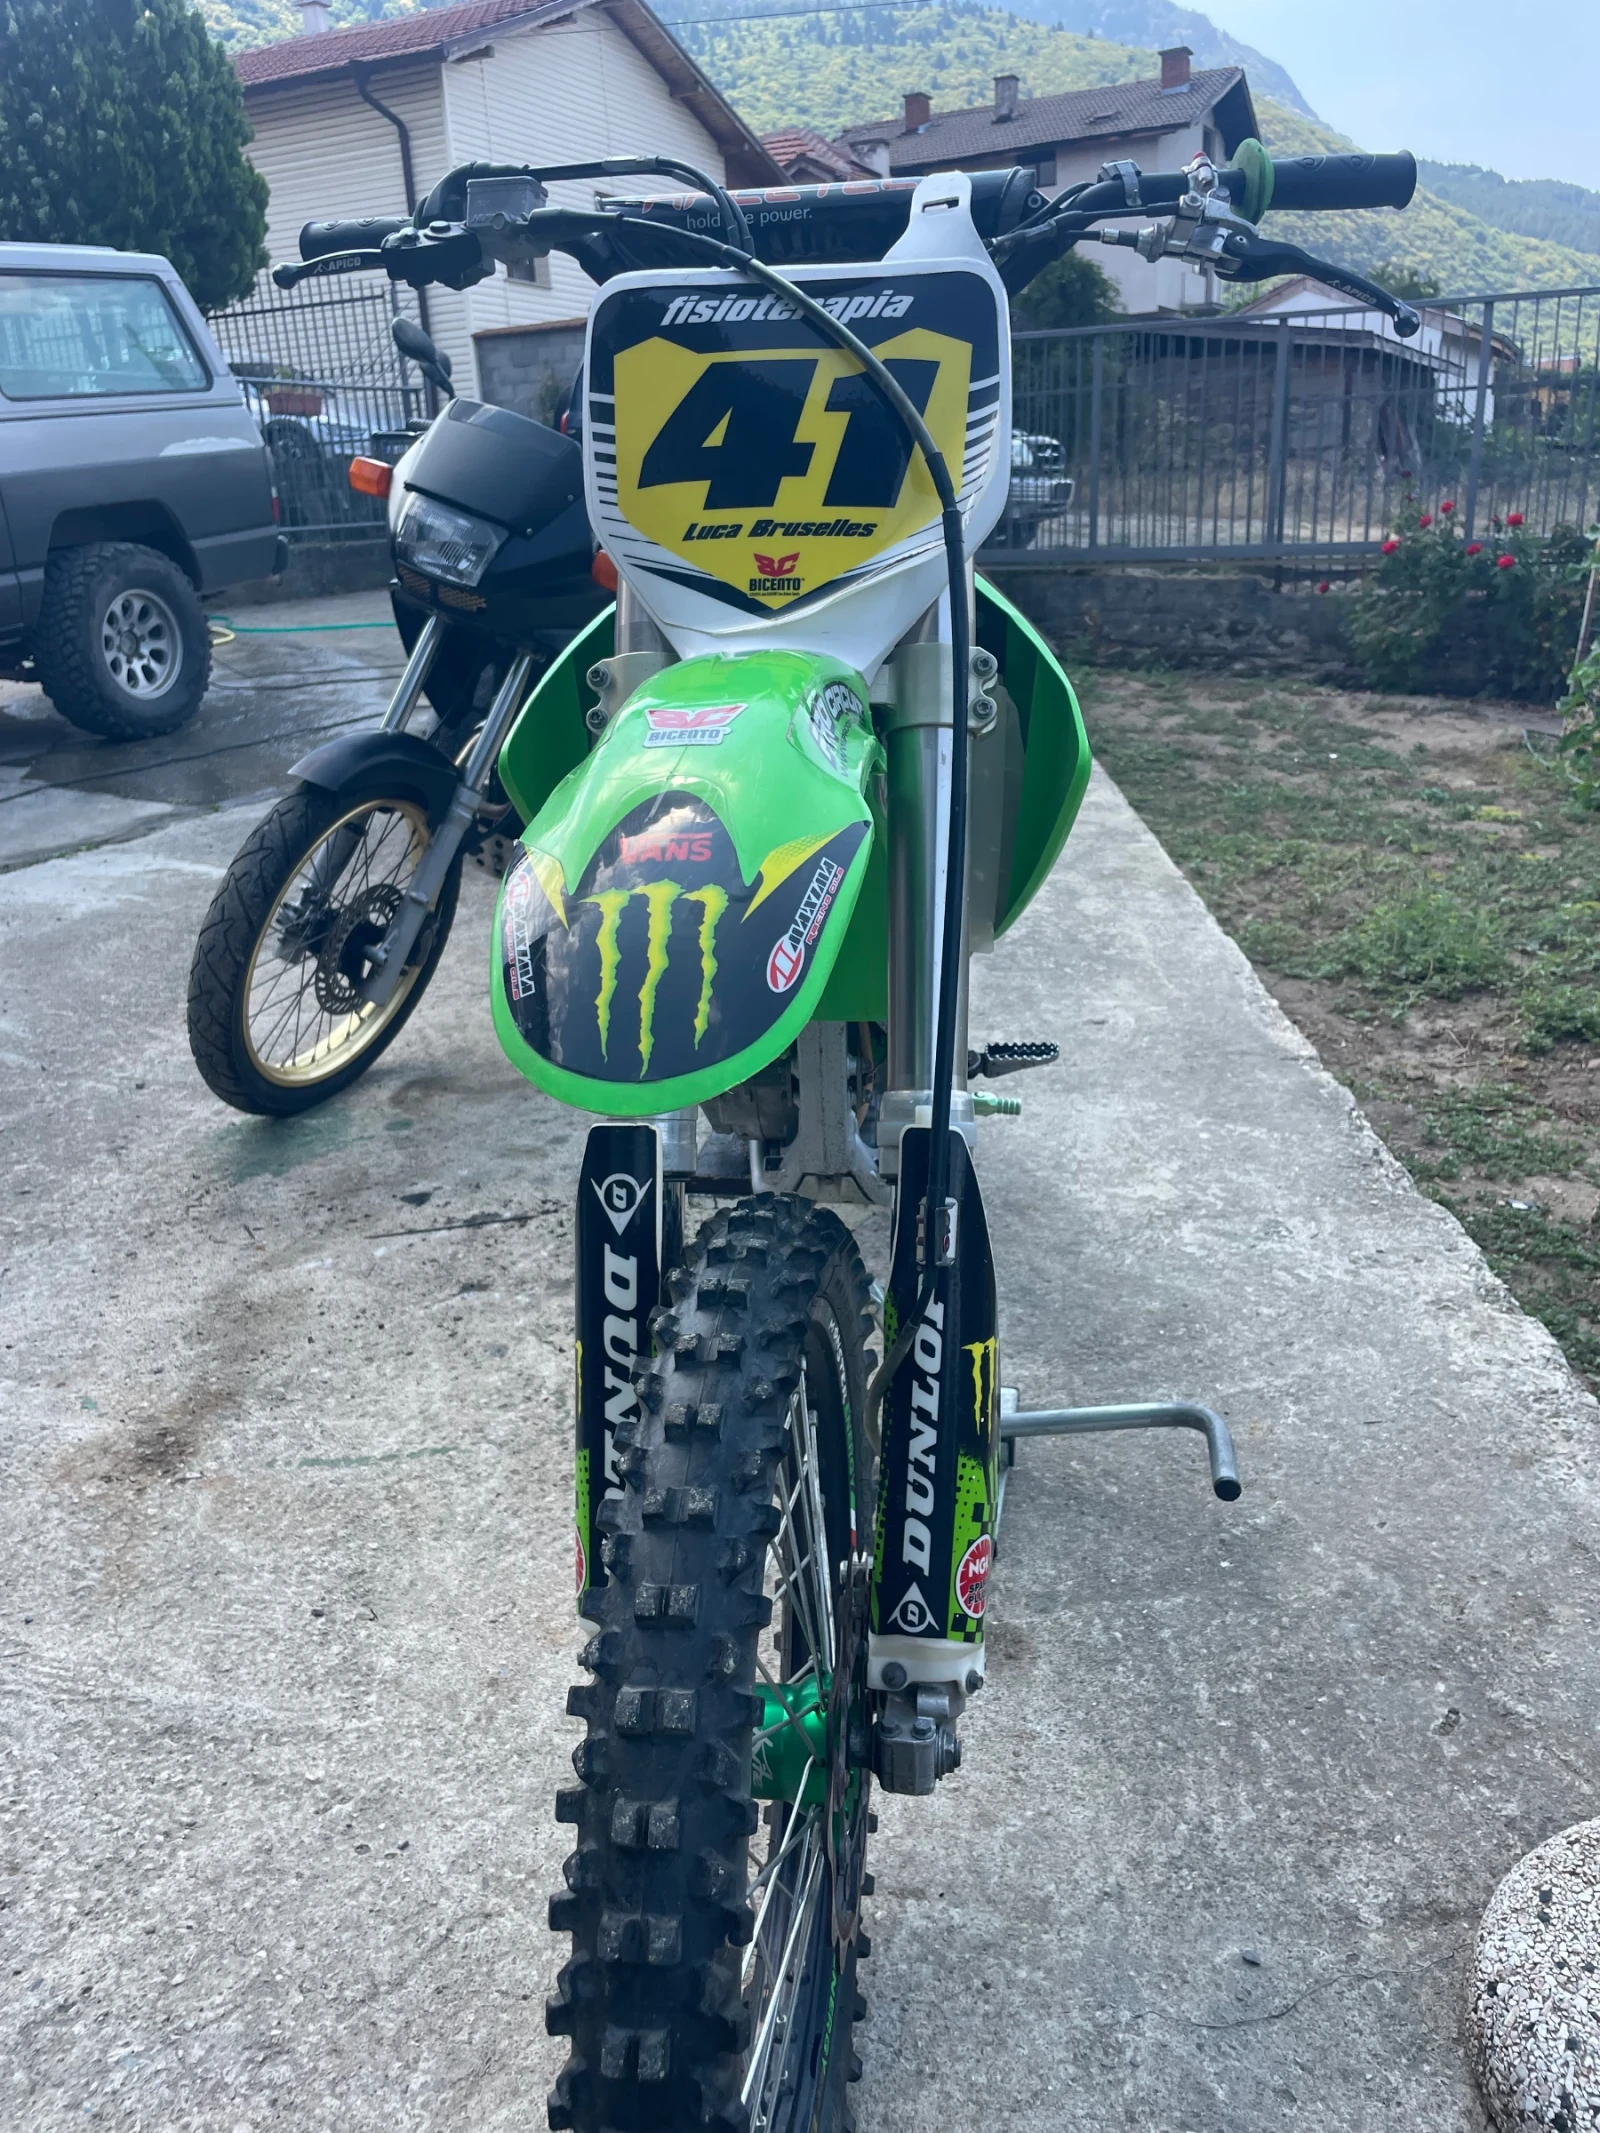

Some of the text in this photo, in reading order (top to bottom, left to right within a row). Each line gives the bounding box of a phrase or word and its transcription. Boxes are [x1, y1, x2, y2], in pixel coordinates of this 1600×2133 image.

[687, 212, 721, 230] hold
[760, 207, 813, 227] power.
[329, 256, 362, 271] APICO
[1342, 284, 1378, 305] APICO
[637, 358, 941, 511] 41
[682, 519, 878, 542] Luca Bruselles
[749, 577, 801, 591] BICENTO
[648, 729, 721, 742] BICENTO
[619, 833, 713, 864] VANS
[805, 866, 845, 945] RACING OILS
[603, 1242, 639, 1501] DUNL
[828, 1317, 848, 1405] MONSTER
